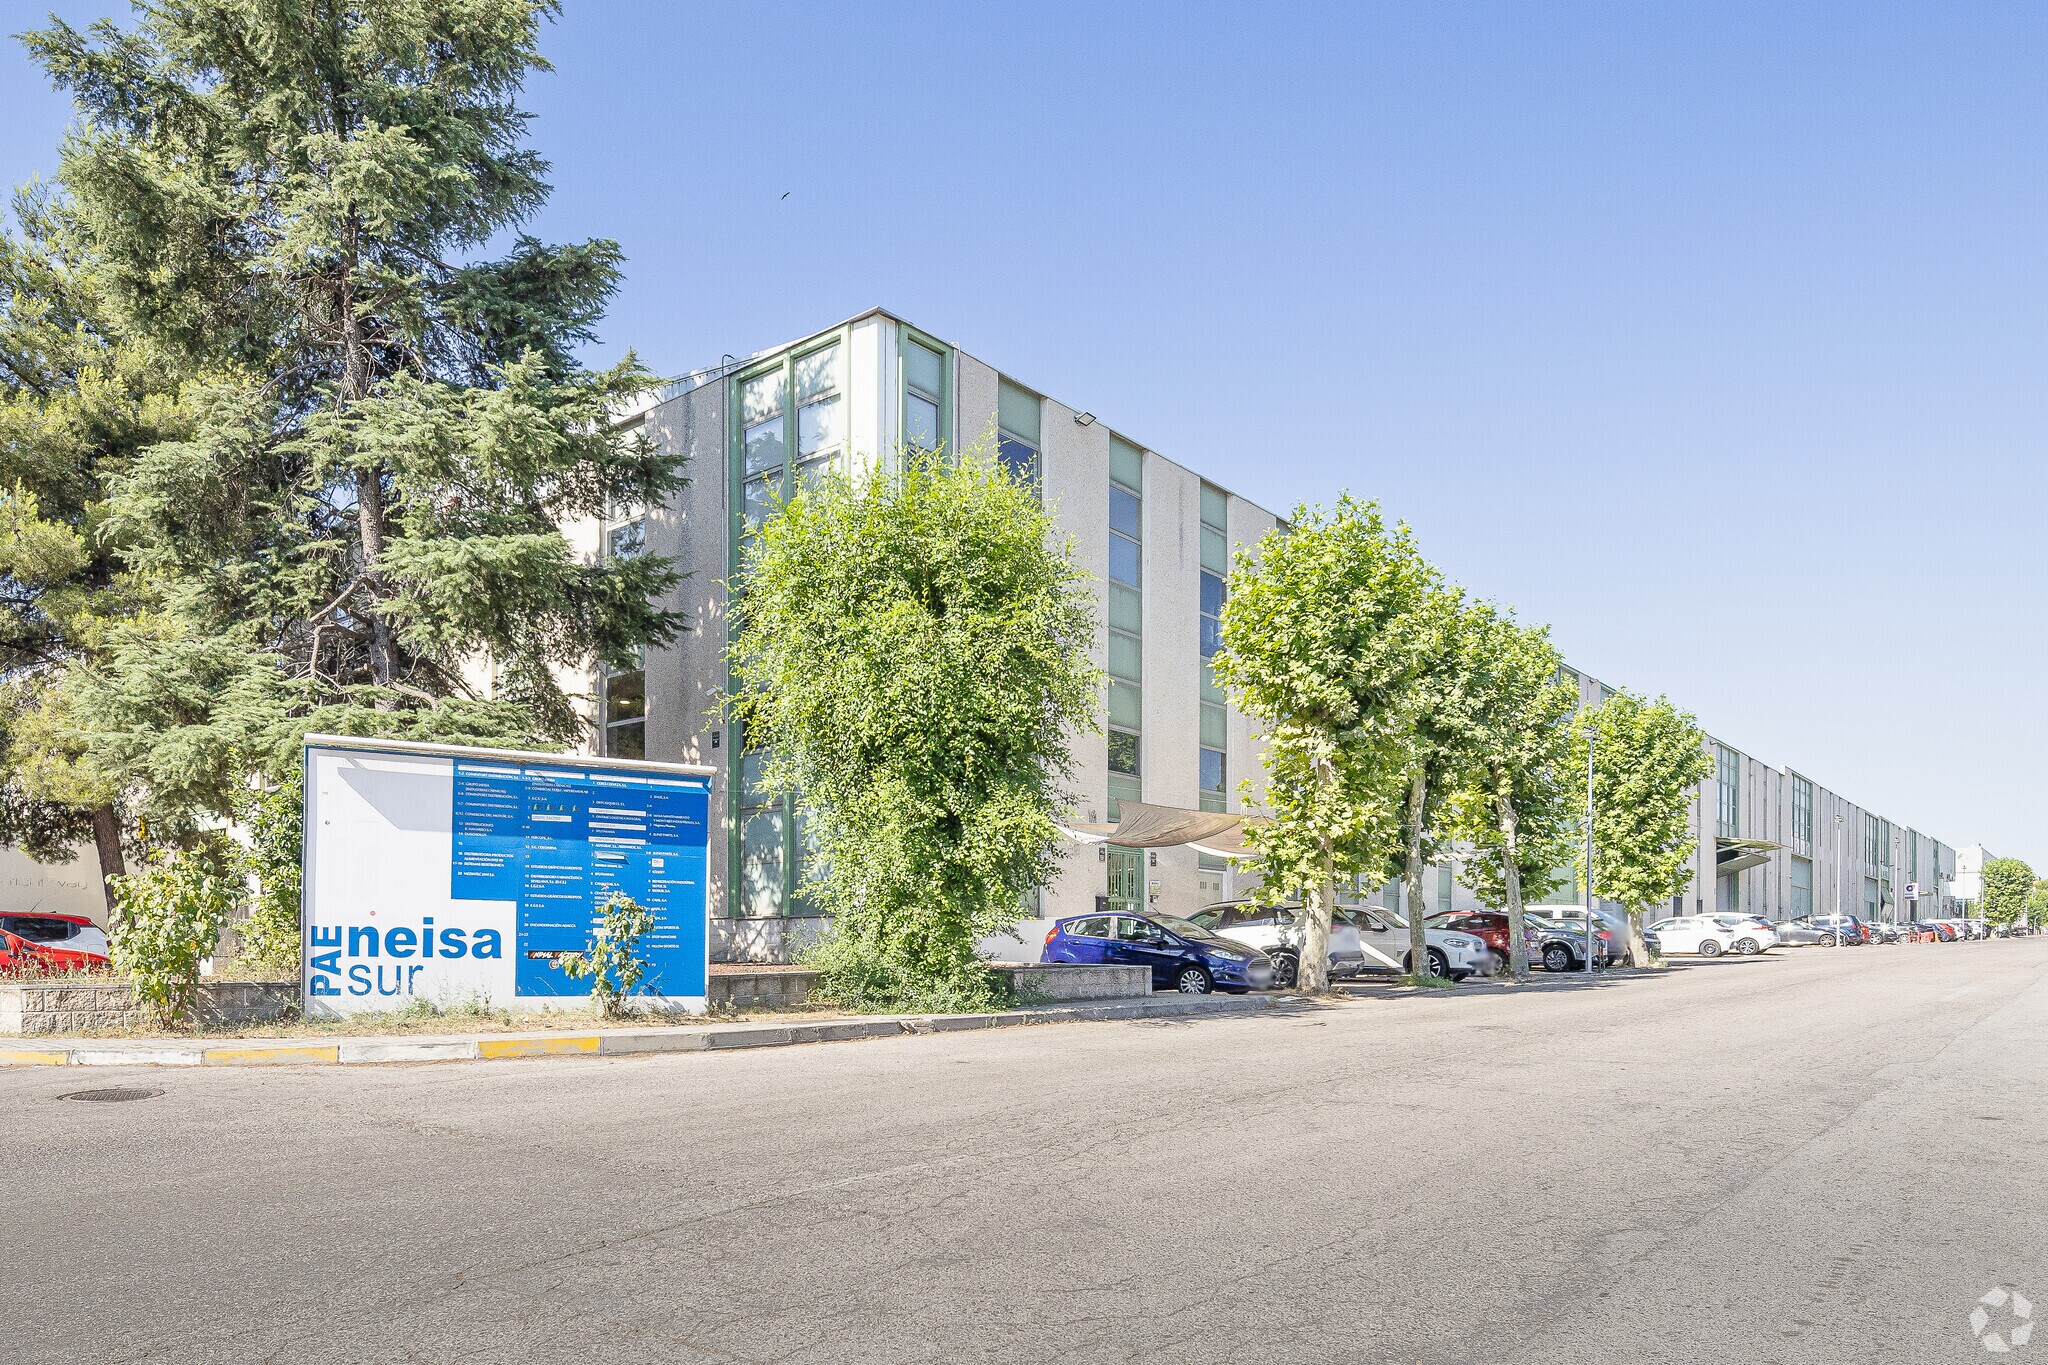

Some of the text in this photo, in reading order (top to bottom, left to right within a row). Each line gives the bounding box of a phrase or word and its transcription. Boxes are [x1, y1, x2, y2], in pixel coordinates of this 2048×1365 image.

[348, 917, 502, 958] neisa
[310, 926, 342, 996] PAE
[348, 965, 424, 996] sur
